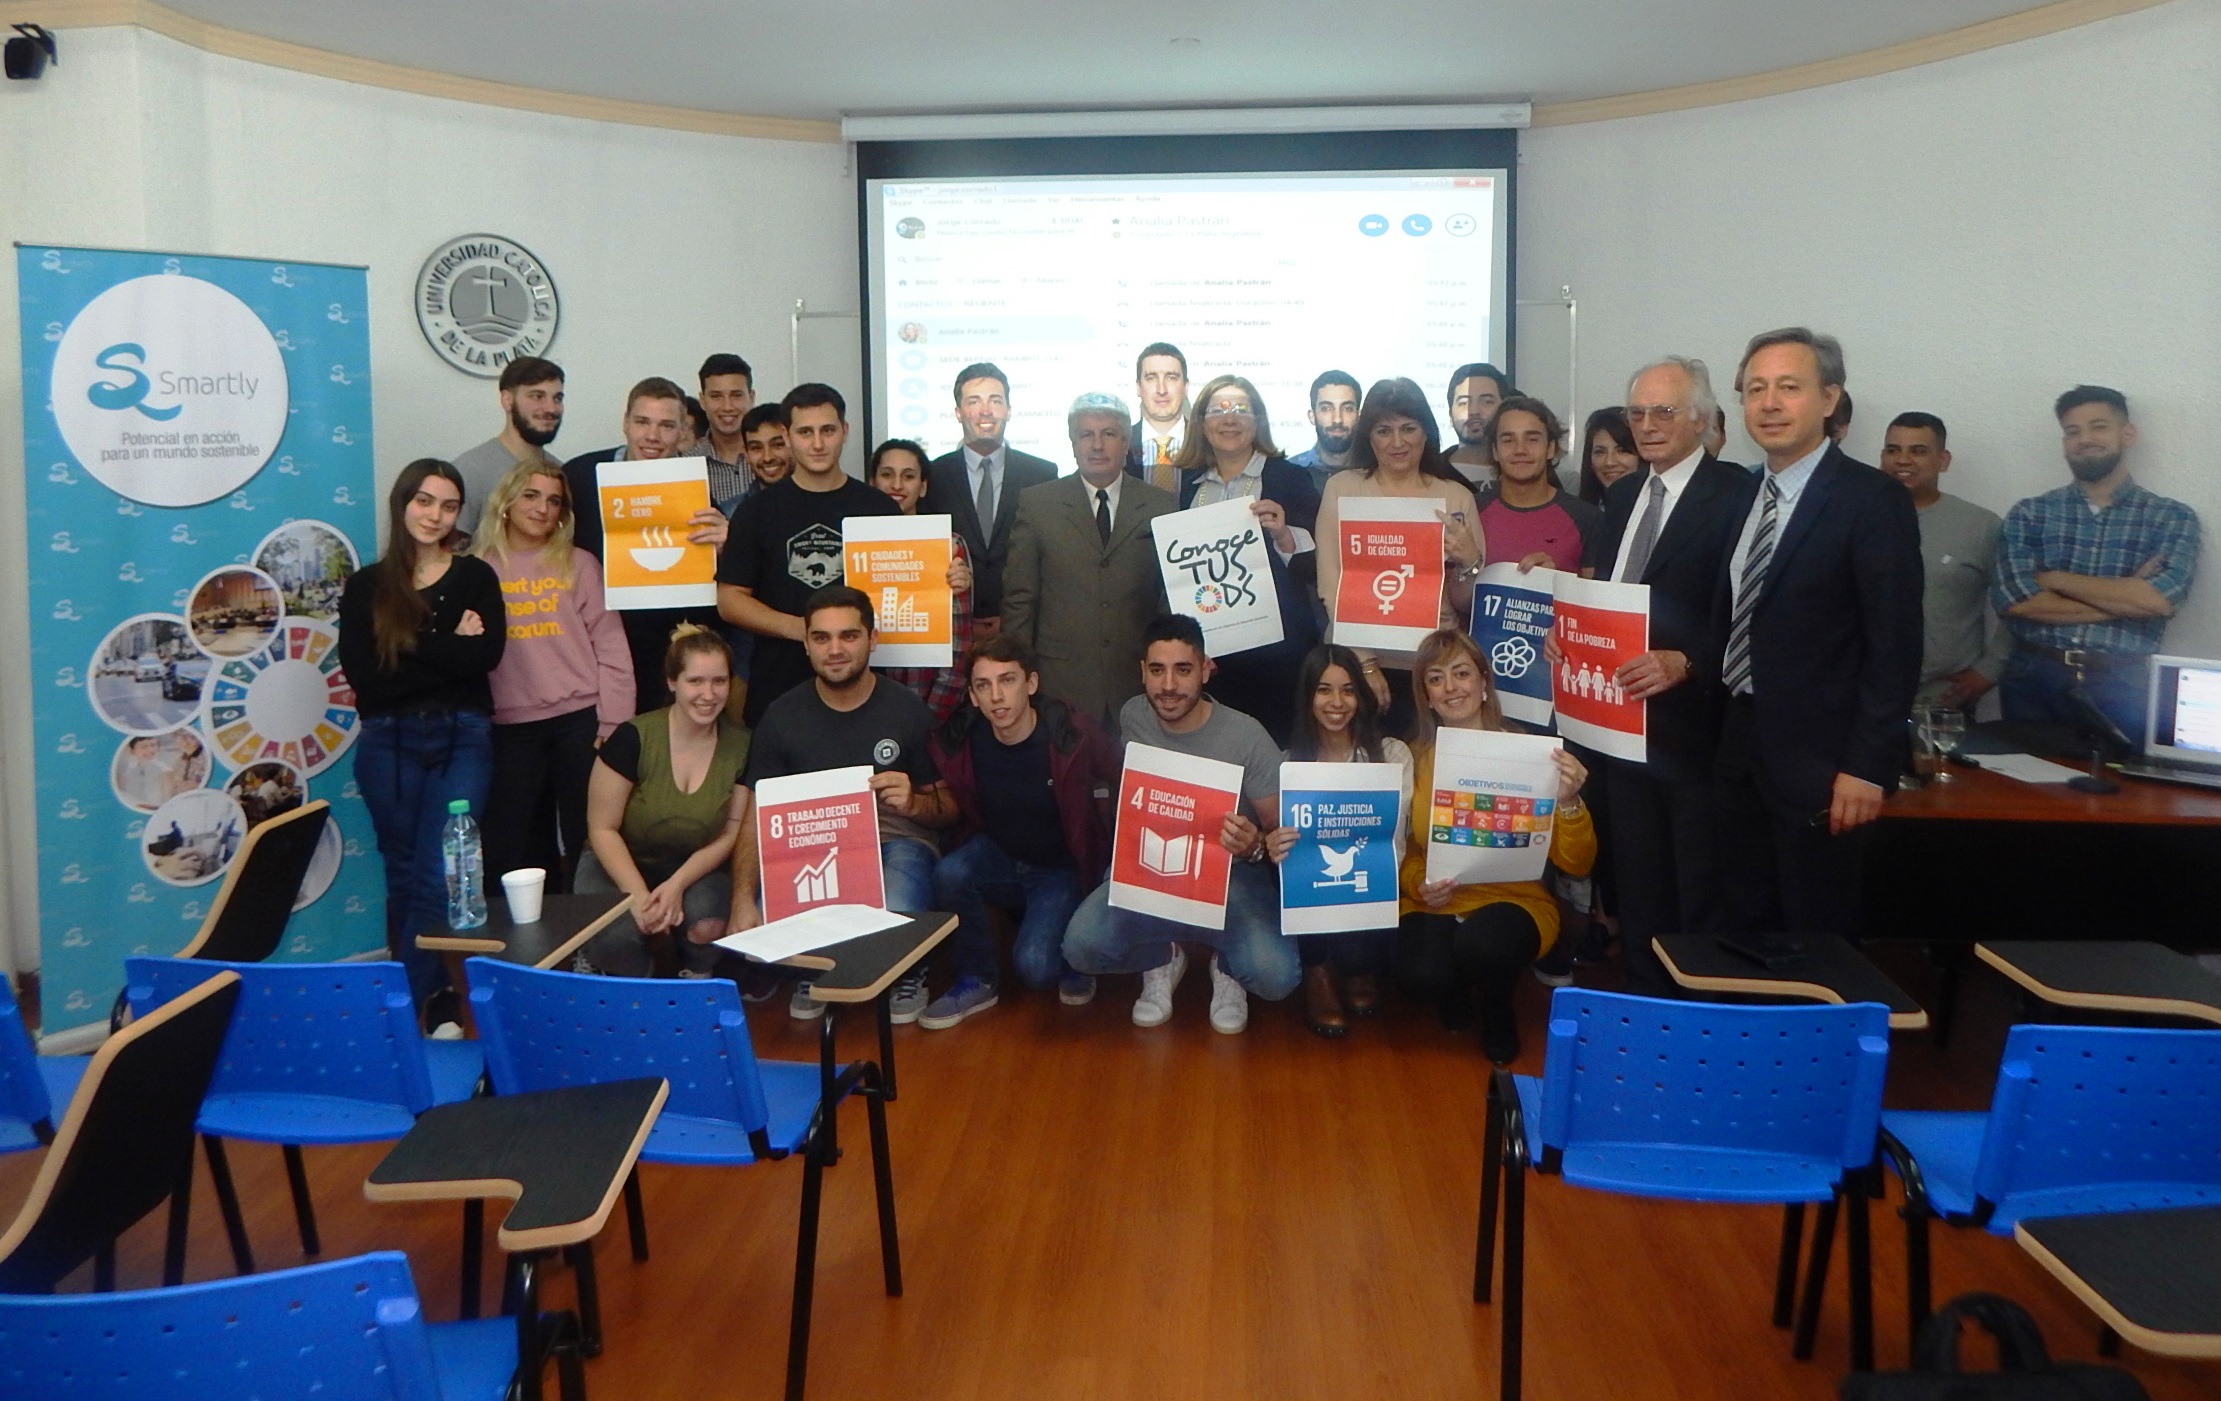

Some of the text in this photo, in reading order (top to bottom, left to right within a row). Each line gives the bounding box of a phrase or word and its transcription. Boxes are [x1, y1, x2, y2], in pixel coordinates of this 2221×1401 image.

[426, 243, 500, 316] UNIVERSIDAD
[440, 329, 539, 368] DE LA PLATA
[160, 371, 259, 400] Smartly
[122, 430, 241, 446] Potencial en acción
[101, 443, 260, 463] para un mundo sostenible
[613, 498, 625, 519] 2
[1167, 529, 1259, 564] Conoce
[1350, 534, 1362, 556] 5
[1367, 534, 1404, 545] IGUALDAD
[871, 549, 914, 561] CIUDADES Y
[1367, 544, 1407, 557] DE GÉNERO
[852, 551, 867, 573] 11
[871, 561, 925, 572] COMUNIDADES
[1179, 547, 1247, 585] TUS
[500, 577, 528, 594] ert
[872, 572, 921, 583] SOSTENIBLES
[505, 592, 559, 617] nse of
[1483, 594, 1502, 618] 17
[1506, 597, 1555, 616] ALIANZAS PAR
[1504, 609, 1533, 623] LOGRAR
[1567, 617, 1577, 630] FIN
[1502, 619, 1549, 637] LOS OBJETIV
[1558, 614, 1565, 638] 1
[1567, 632, 1616, 651] DE LA POBREZA
[1458, 778, 1505, 790] OBJETIVOS
[1131, 786, 1145, 810] 4
[1149, 789, 1196, 809] EDUCACIÓN
[787, 803, 861, 824] TRABAJO DECENTE
[1148, 802, 1195, 822] DE CALIDAD
[1291, 803, 1313, 829] 16
[1337, 803, 1374, 815] JUSTICIA
[770, 814, 783, 839] 8
[788, 817, 848, 836] Y CRECIMIENTO
[1318, 815, 1382, 828] E INSTITUCIONES
[788, 831, 837, 849] ECONÓMICO
[1316, 828, 1351, 840] SÓLIDAS
